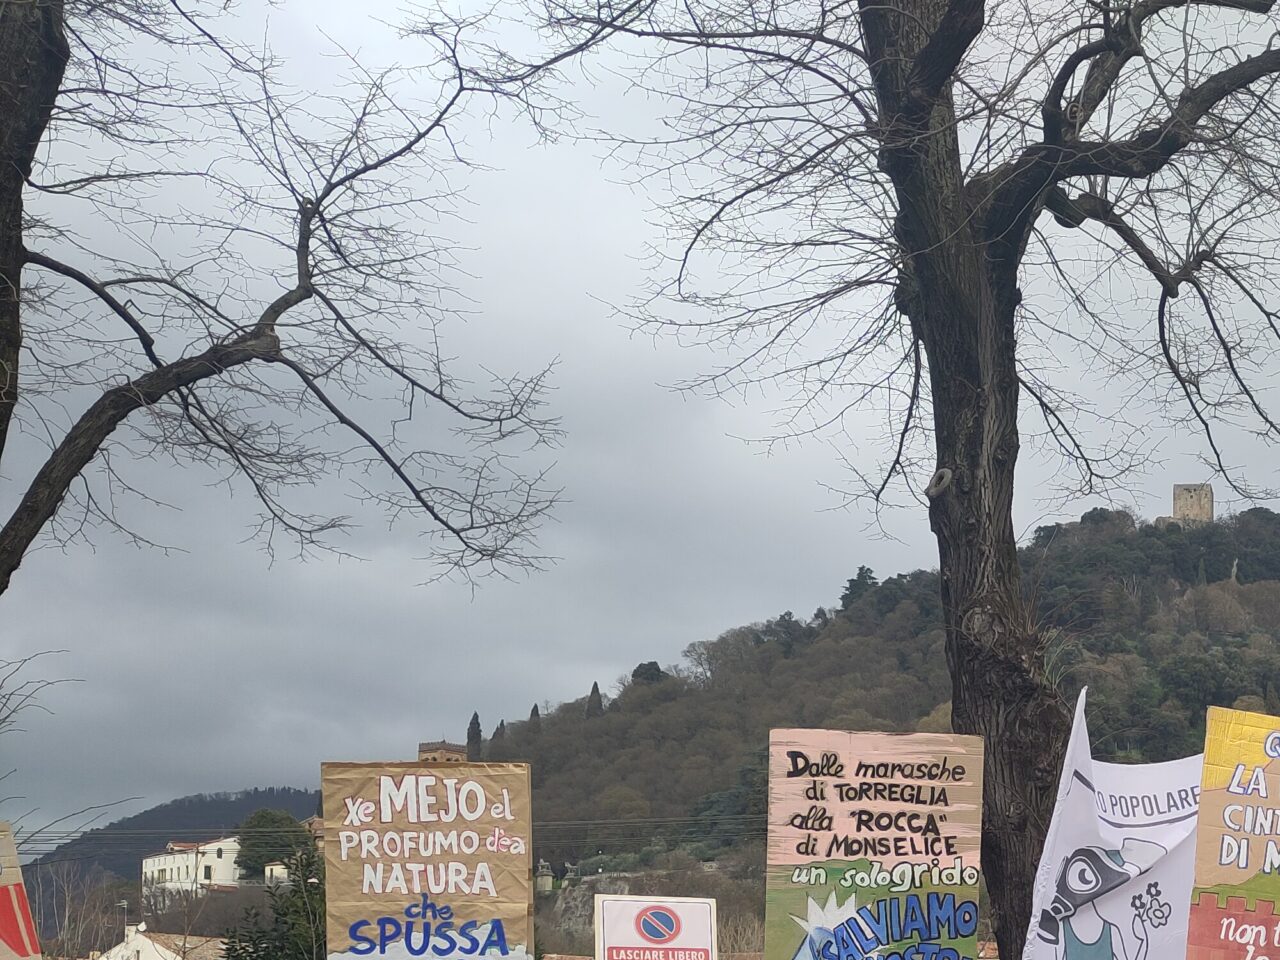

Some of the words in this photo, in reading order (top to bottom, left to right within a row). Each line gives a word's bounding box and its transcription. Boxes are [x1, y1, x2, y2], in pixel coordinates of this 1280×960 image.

[786, 750, 845, 779] Dalle
[855, 756, 966, 782] marasche
[1227, 763, 1268, 799] LA
[379, 774, 486, 824] MEJO
[490, 788, 515, 821] el
[805, 780, 826, 801] di
[1109, 785, 1200, 818] POPOLARE
[787, 805, 833, 831] alla
[338, 829, 480, 861] PROFUMO
[796, 833, 818, 856] di
[826, 834, 958, 858] MONSELICE
[1219, 834, 1249, 869] DI
[362, 861, 498, 897] NATURA
[791, 864, 827, 886] un
[404, 893, 454, 920] che
[349, 916, 510, 956] SPUSSA
[612, 949, 665, 960] LASCIARE
[669, 950, 705, 960] LIBERO
